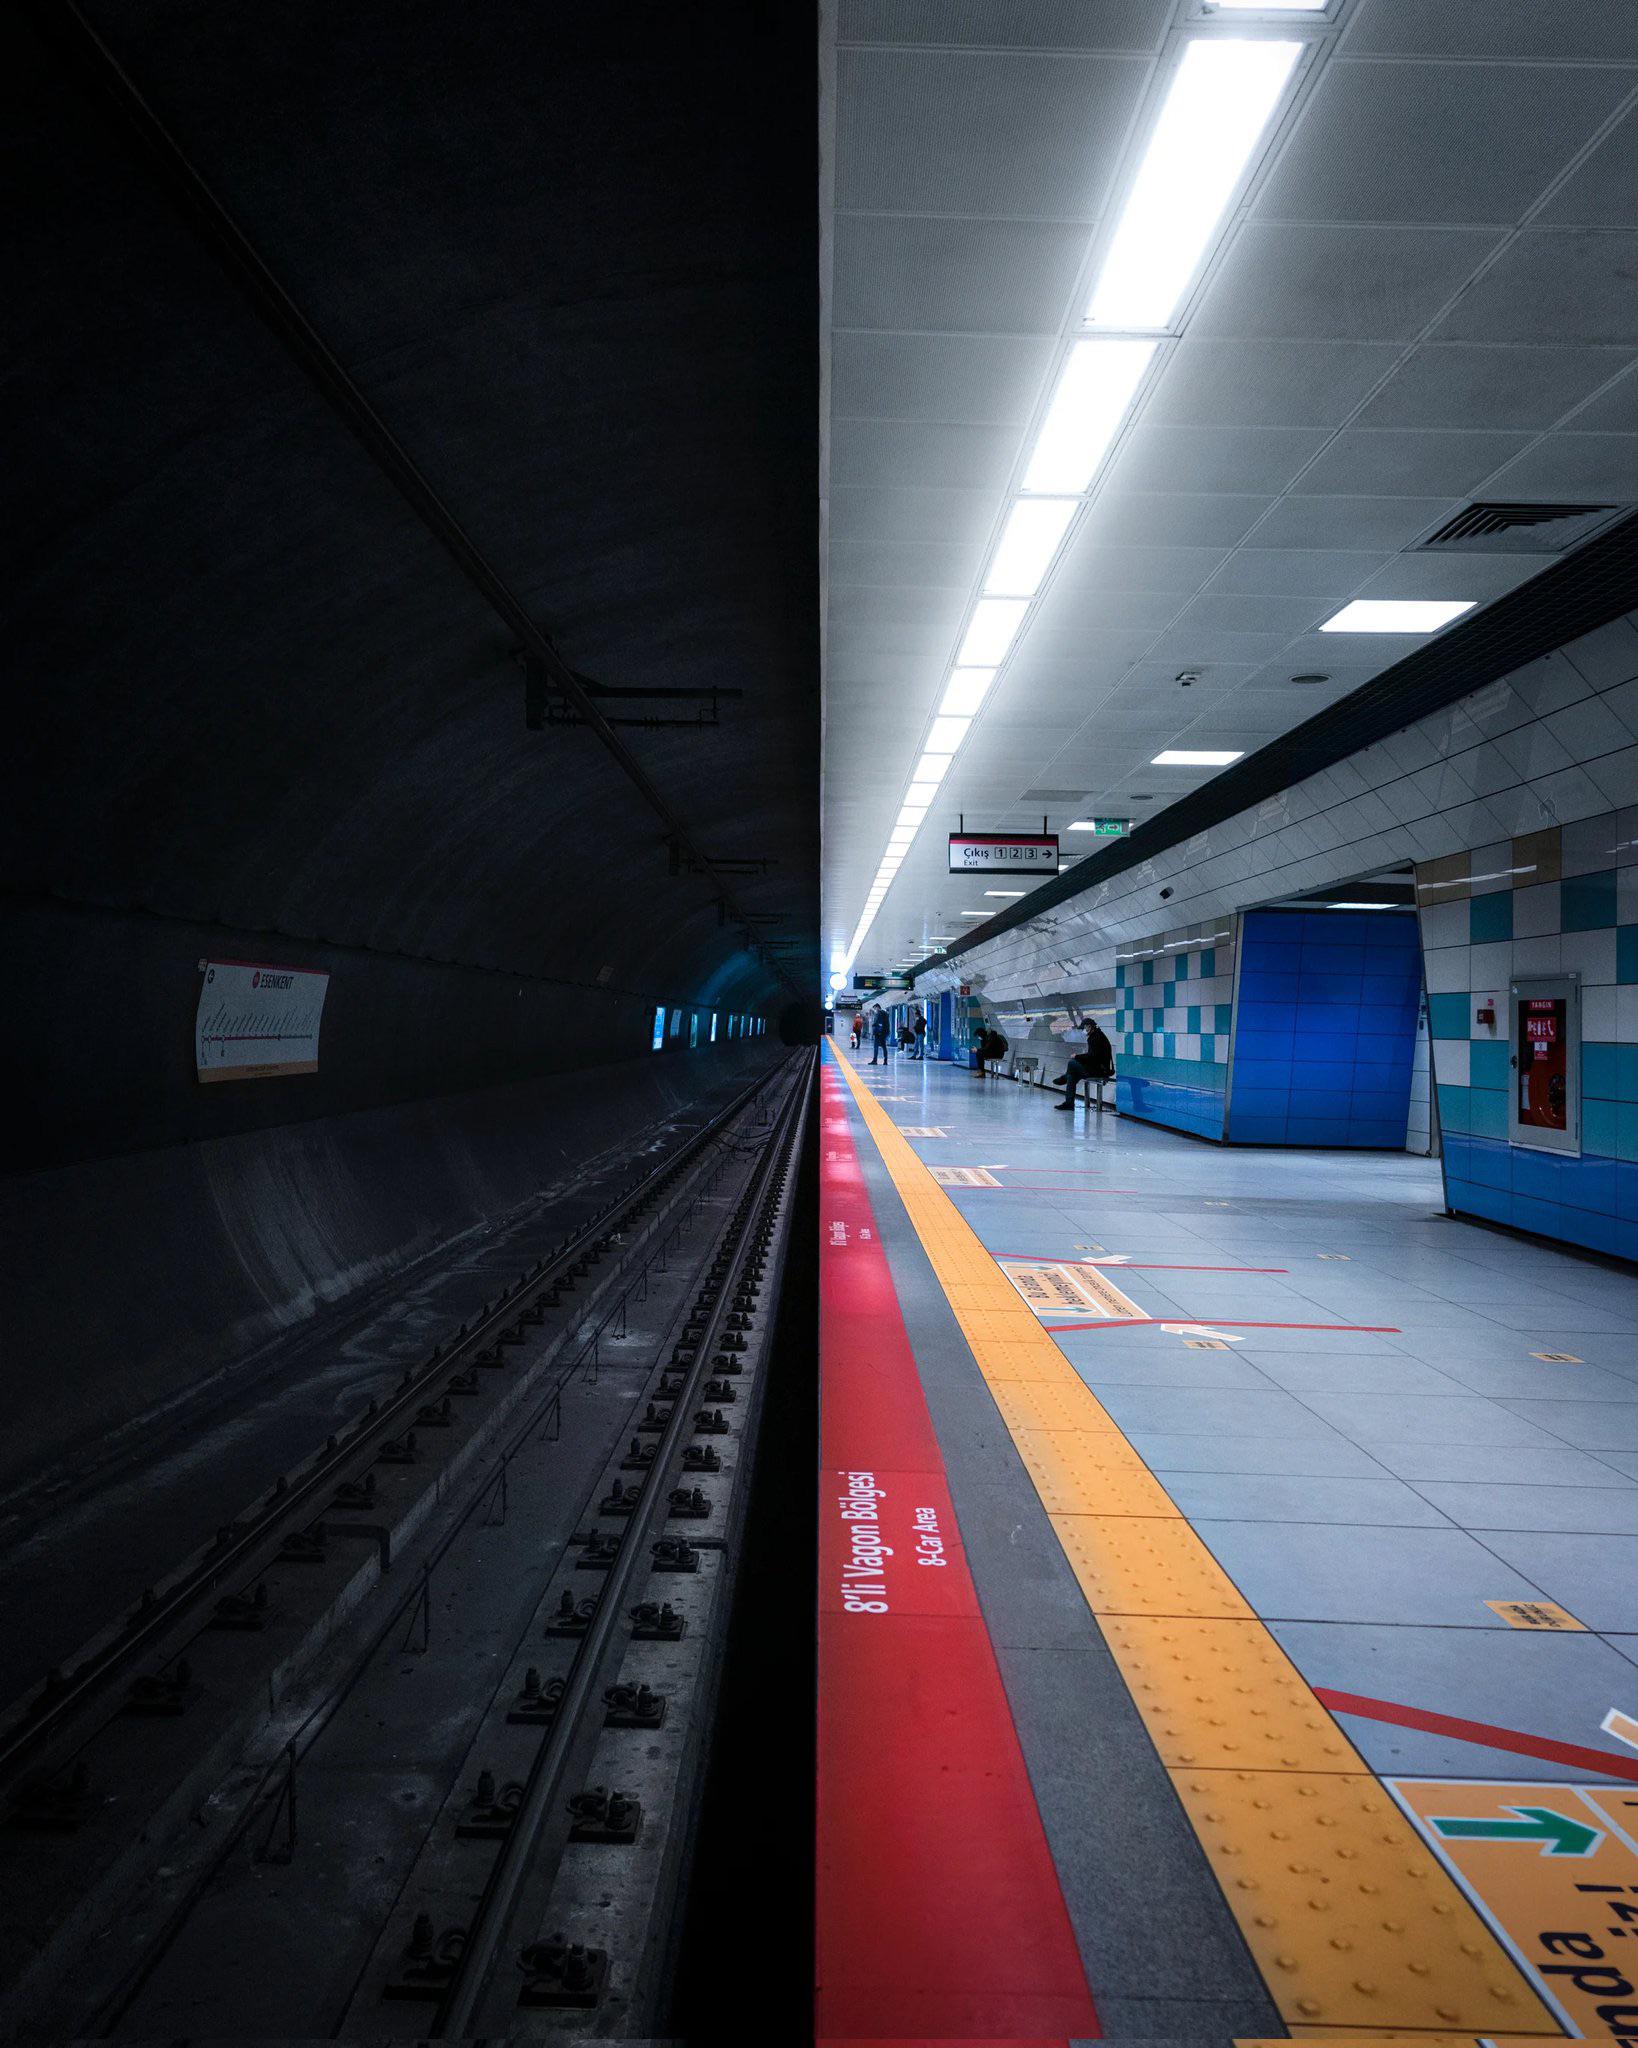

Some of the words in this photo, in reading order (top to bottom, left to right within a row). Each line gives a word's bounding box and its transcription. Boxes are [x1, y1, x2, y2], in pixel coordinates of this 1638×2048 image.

[963, 847, 990, 859] Çıkış
[963, 859, 978, 867] Exit
[260, 974, 294, 990] ESENKENT
[837, 1471, 887, 1521] Bölgesi
[911, 1506, 940, 1533] Area
[842, 1524, 895, 1579] Vagon
[913, 1534, 948, 1567] 8-Car
[840, 1583, 890, 1615] 8'li
